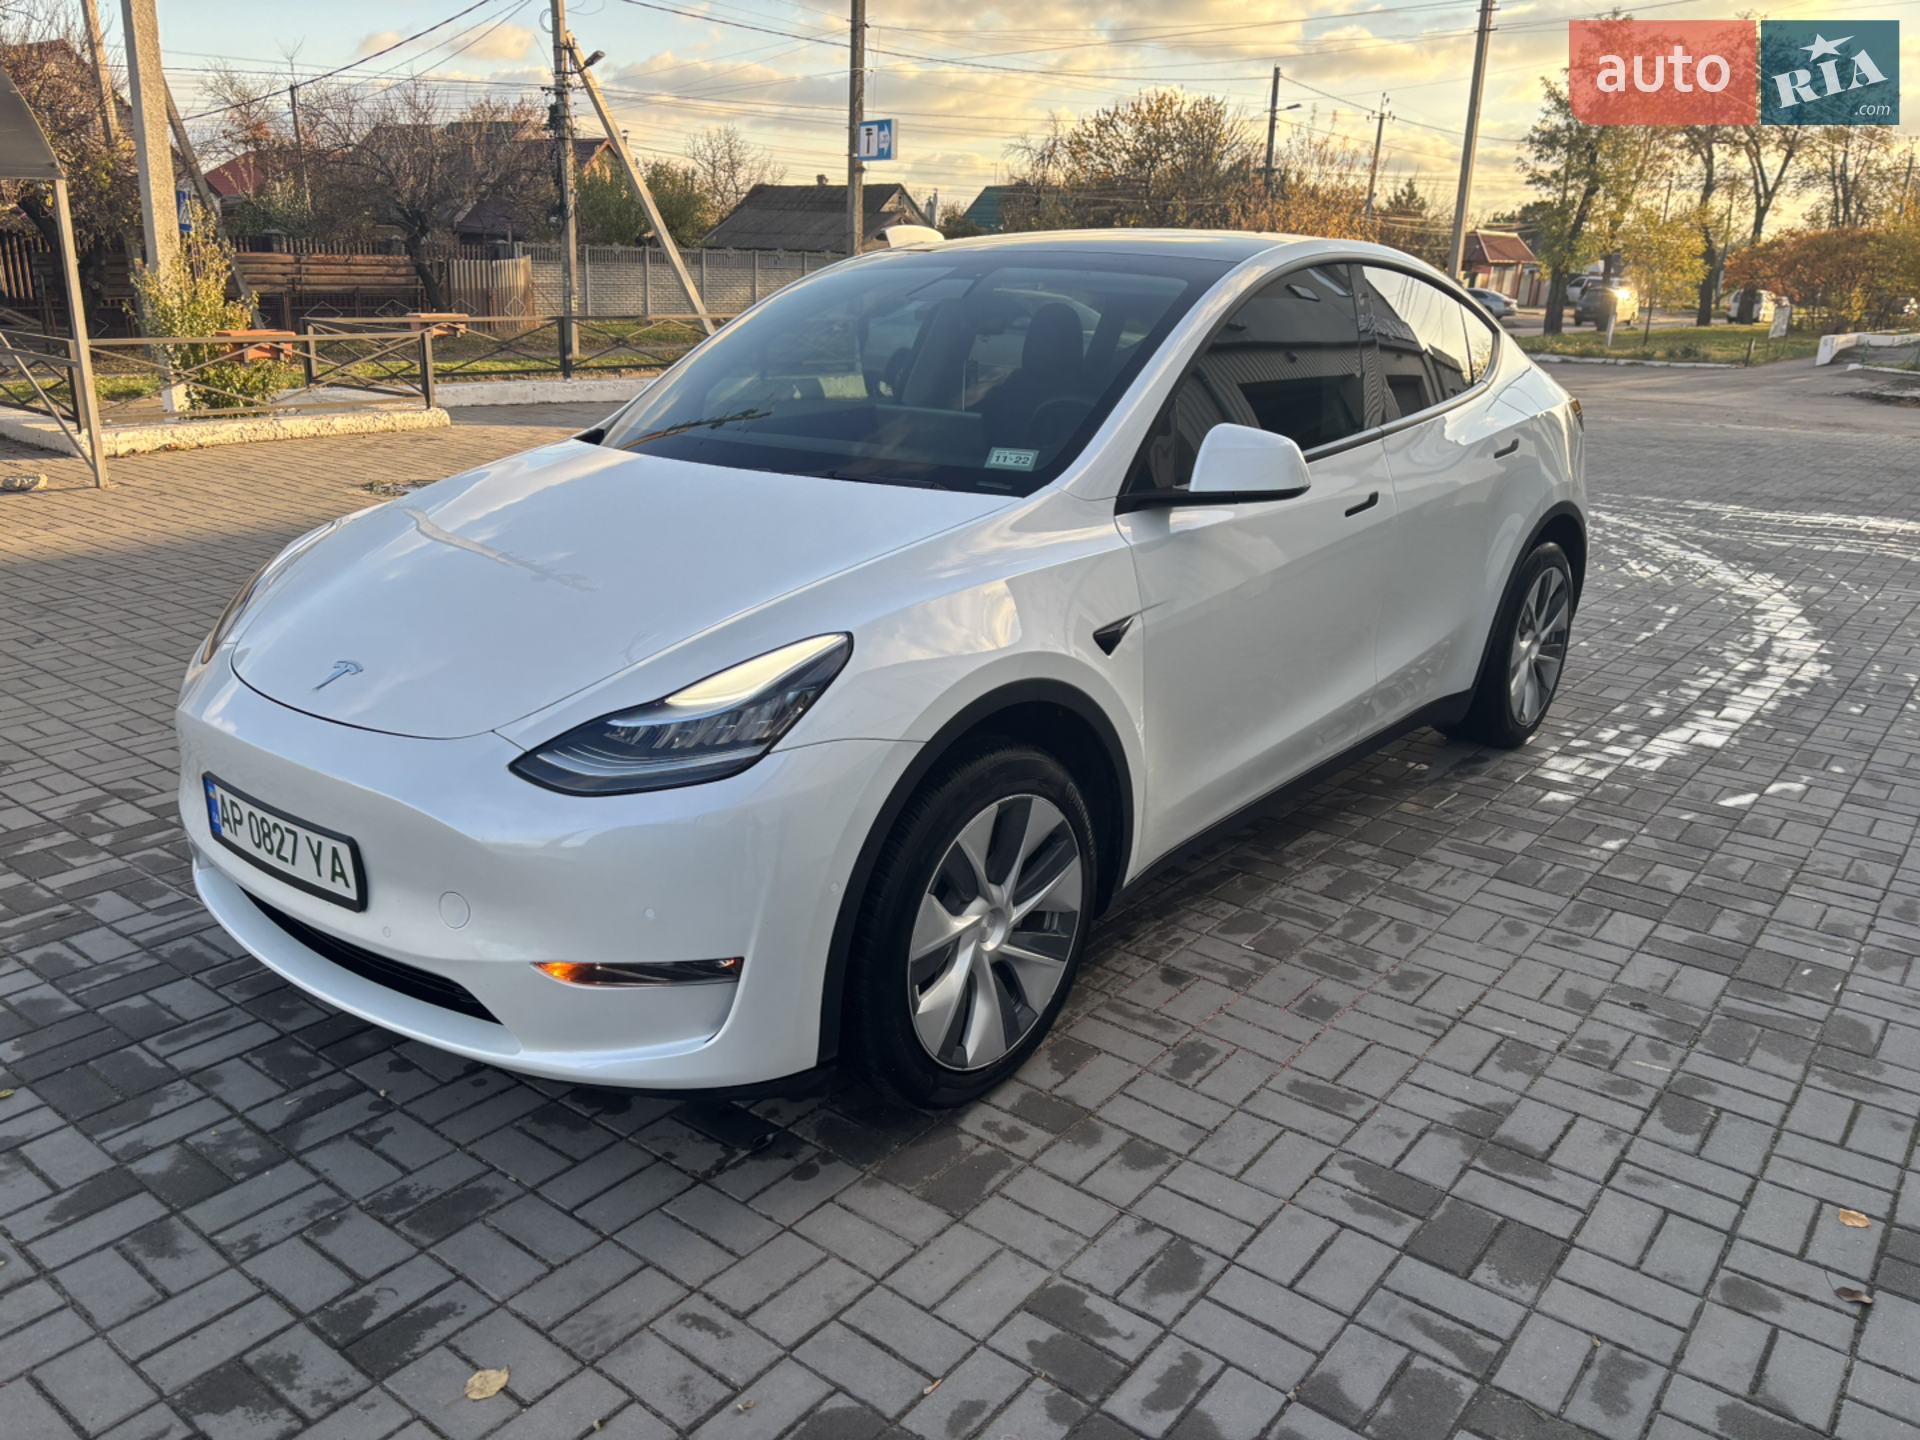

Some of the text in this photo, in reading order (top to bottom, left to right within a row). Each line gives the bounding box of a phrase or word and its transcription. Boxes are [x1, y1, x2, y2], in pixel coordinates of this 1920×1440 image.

[220, 793, 350, 889] AP 0827 YA
